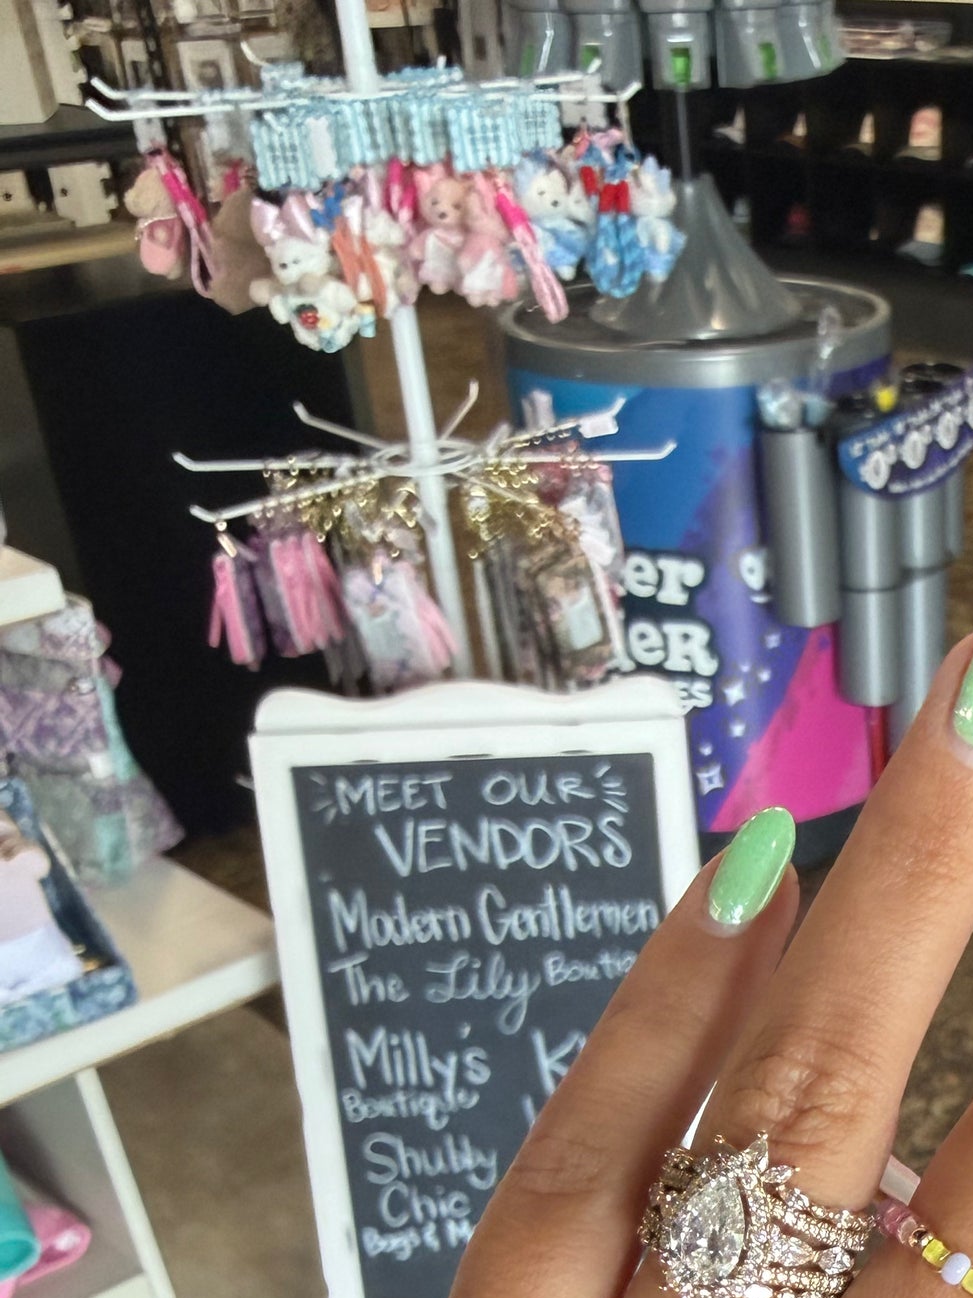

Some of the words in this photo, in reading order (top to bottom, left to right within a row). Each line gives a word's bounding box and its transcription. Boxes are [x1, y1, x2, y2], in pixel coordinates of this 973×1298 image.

[335, 773, 452, 816] MEET
[481, 771, 595, 806] OUR
[373, 811, 632, 878] VENDORS
[326, 887, 472, 952] Modern
[476, 882, 659, 946] Gentlemen
[328, 951, 409, 1006] The
[425, 950, 541, 1036] Lily
[345, 1021, 491, 1106] Milly's
[378, 1180, 471, 1228] Chic
